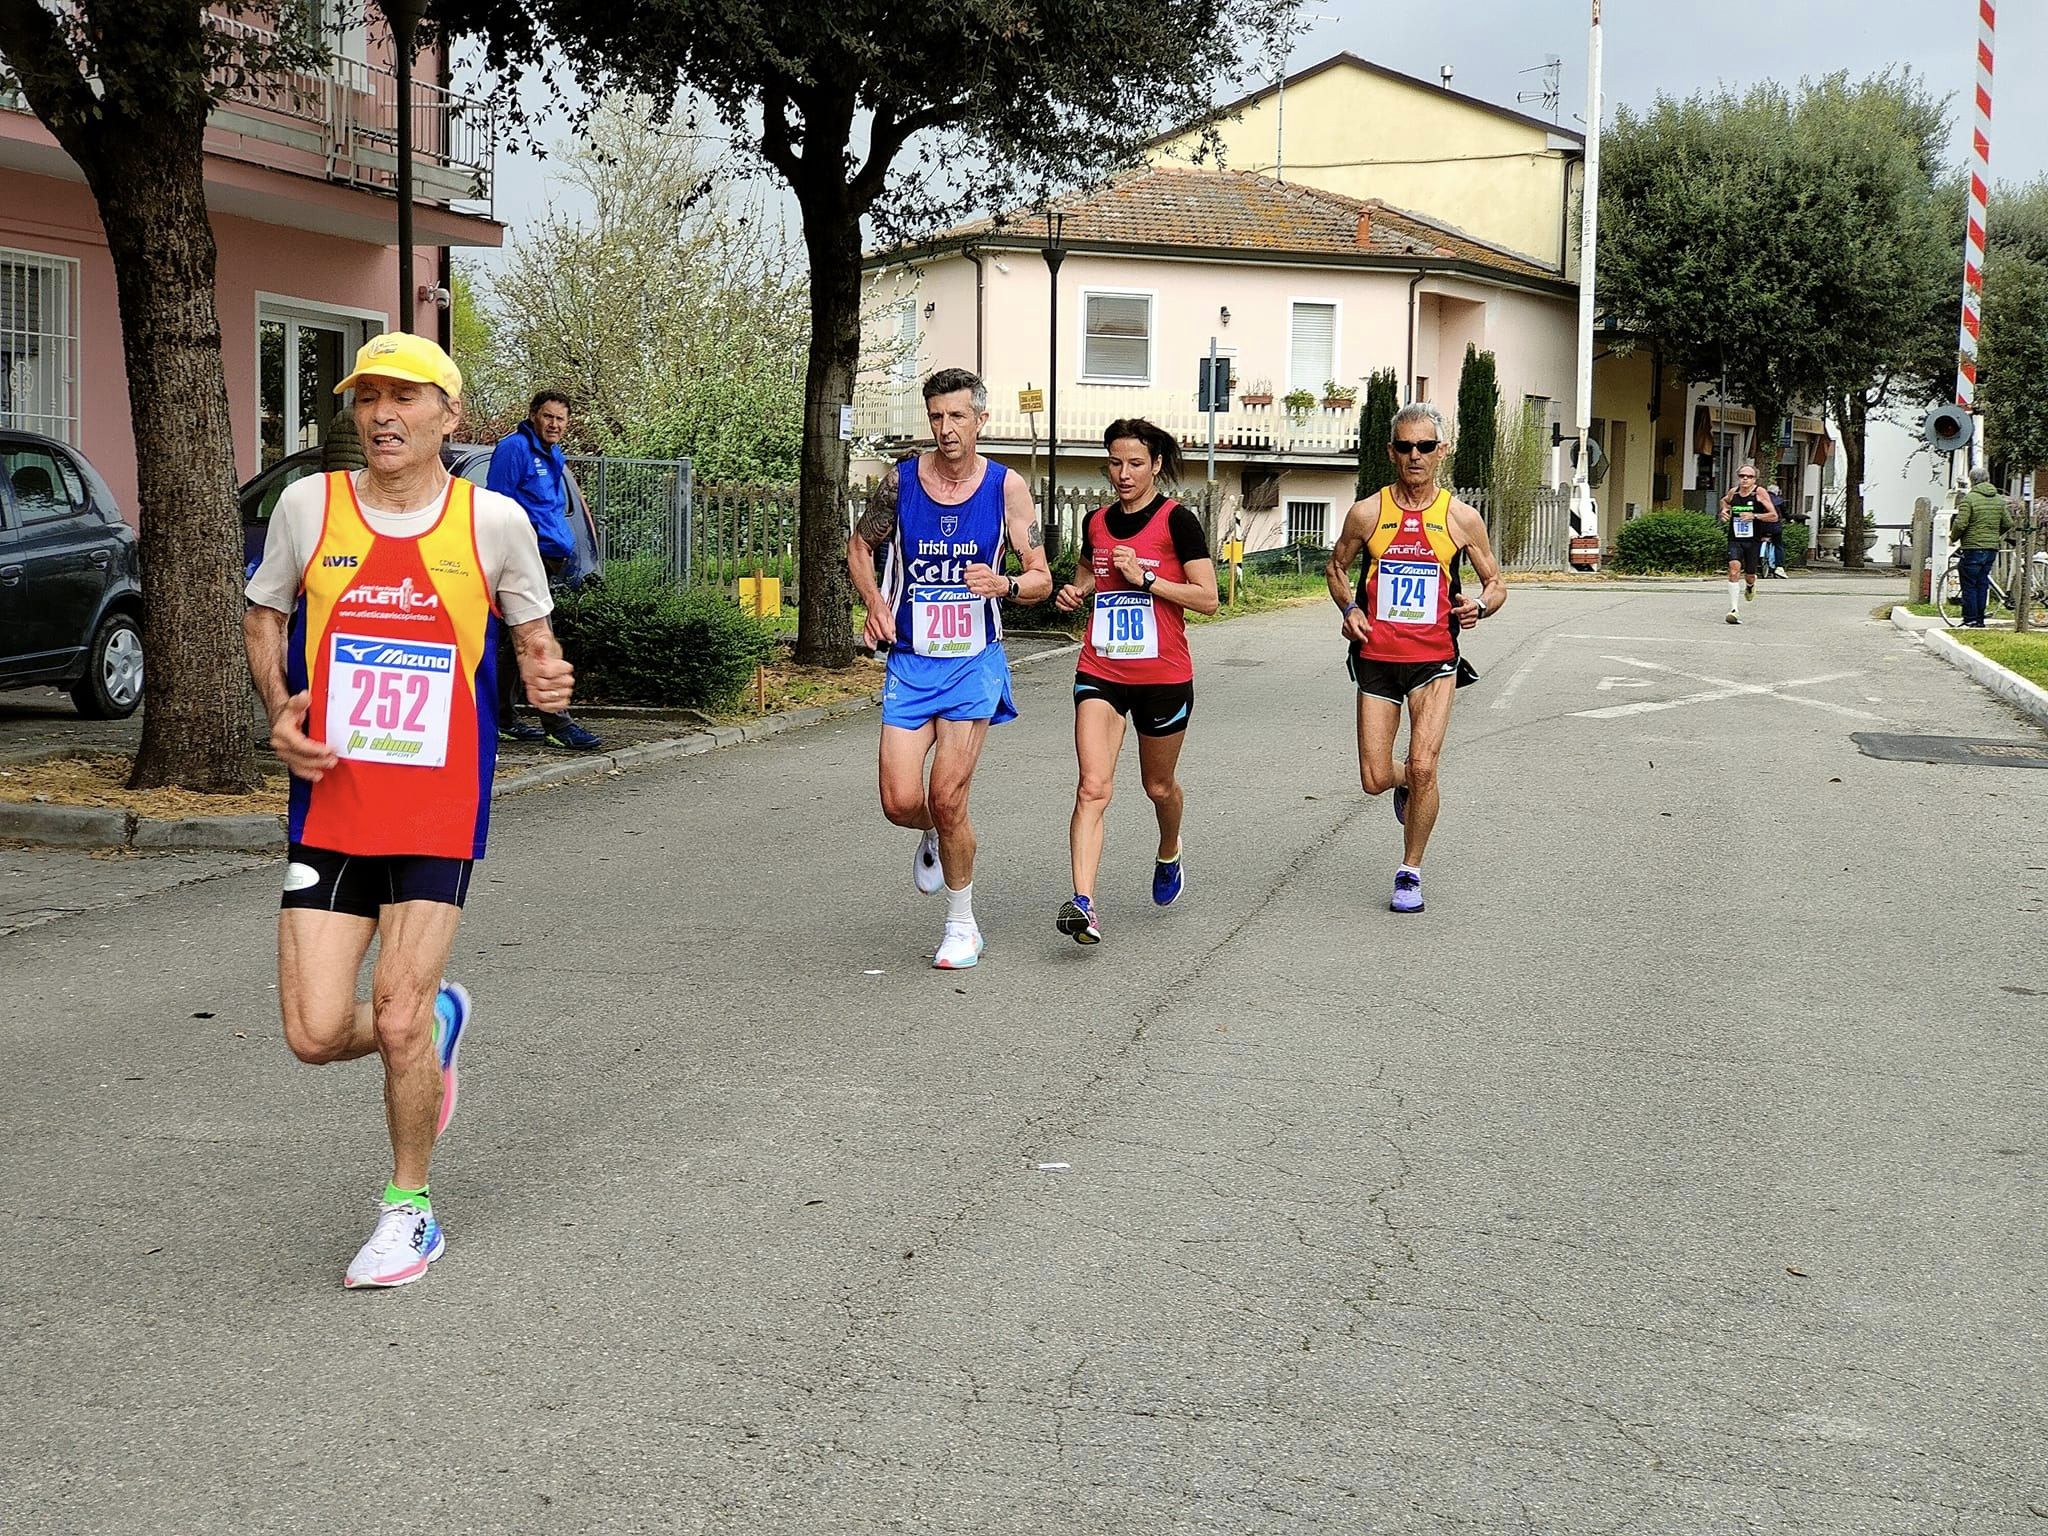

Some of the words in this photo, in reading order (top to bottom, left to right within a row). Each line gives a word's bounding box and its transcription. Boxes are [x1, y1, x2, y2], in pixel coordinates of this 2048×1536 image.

[323, 556, 358, 568] AVIS
[918, 540, 948, 555] irish
[953, 540, 978, 558] pub
[908, 558, 972, 583] Celt
[340, 583, 438, 611] ATLETICA
[1391, 577, 1426, 607] 124
[926, 604, 972, 638] 205
[1107, 608, 1144, 641] 198
[348, 669, 430, 732] 252
